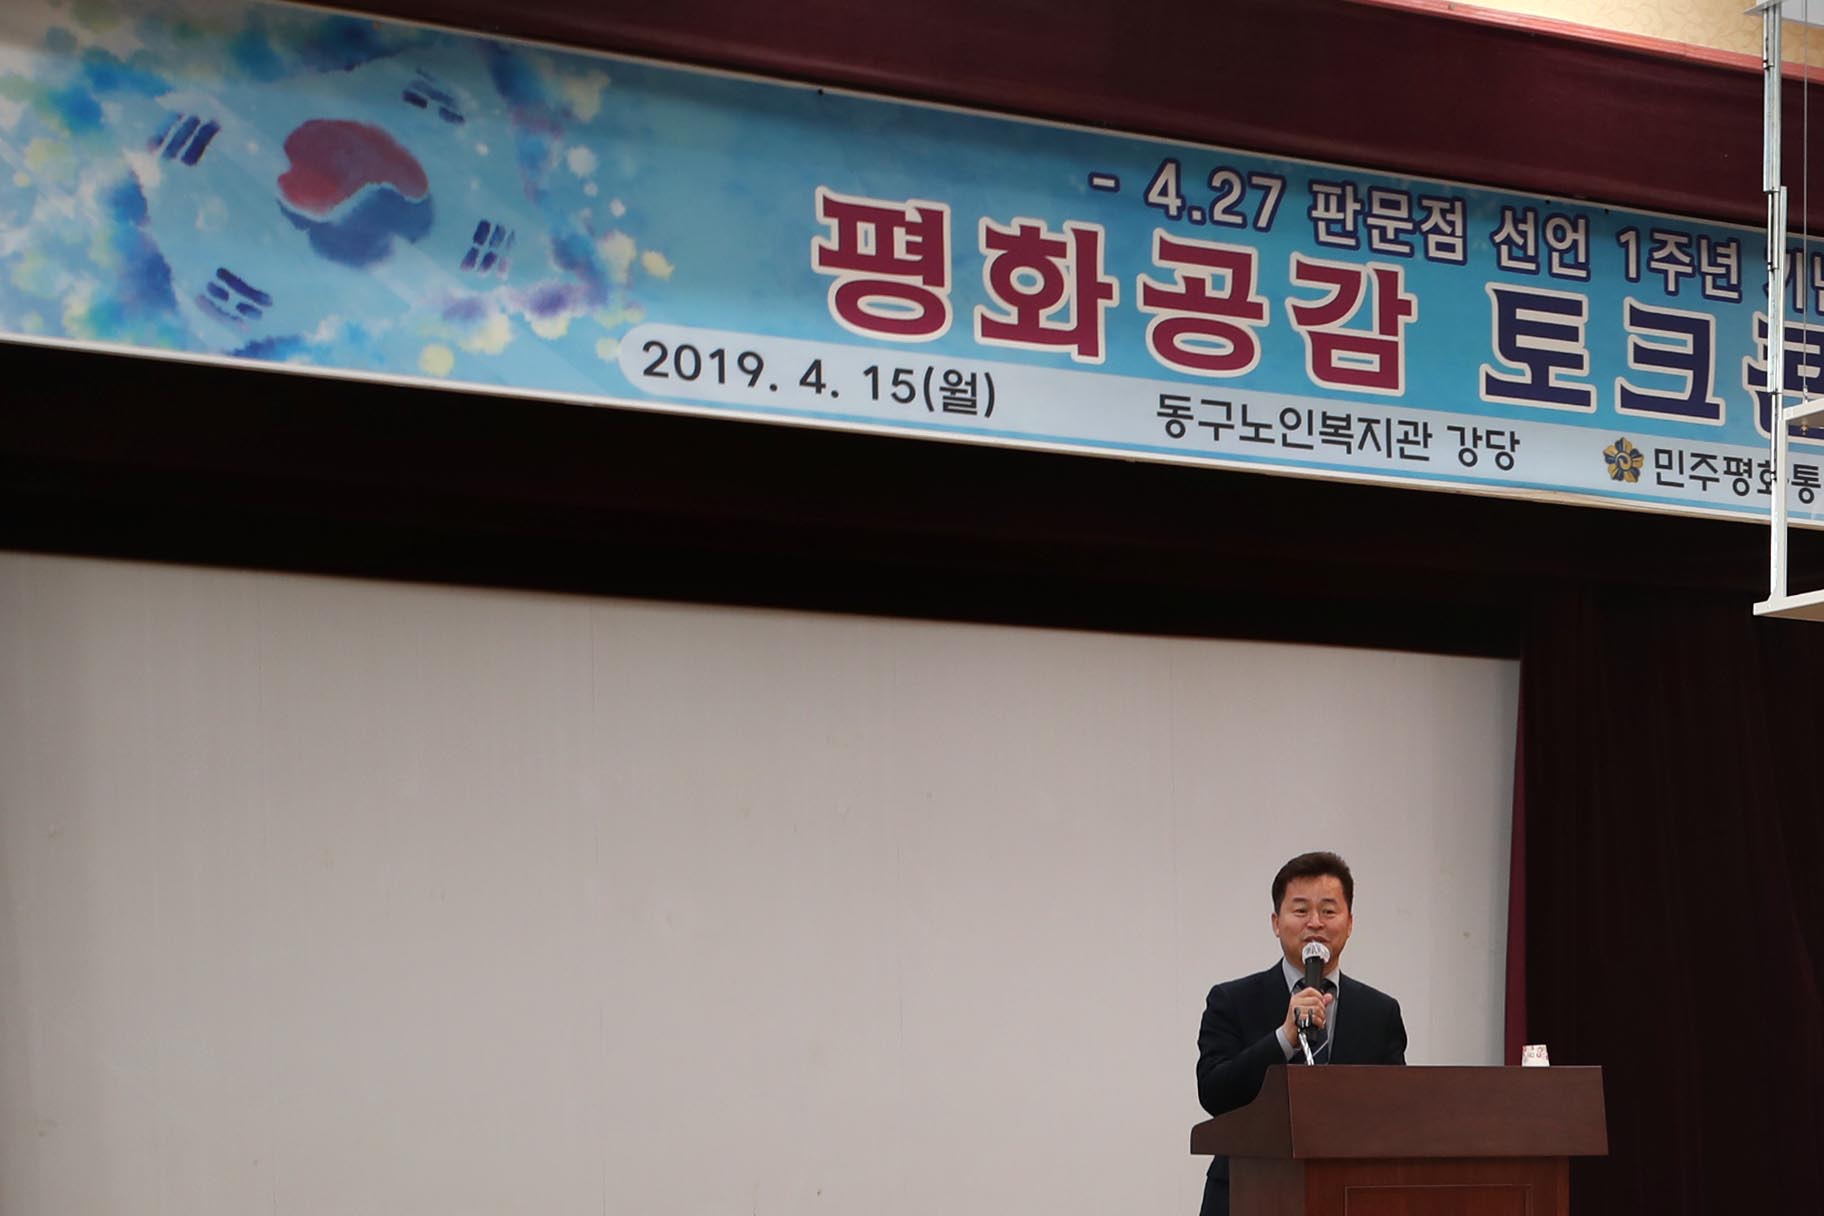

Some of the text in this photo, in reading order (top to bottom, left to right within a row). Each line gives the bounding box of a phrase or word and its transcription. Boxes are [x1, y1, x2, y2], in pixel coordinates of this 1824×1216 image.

[1146, 159, 1286, 231] 4.27
[1308, 181, 1466, 265] 판문점
[1491, 207, 1589, 280] 선언
[1618, 227, 1741, 301] 1주년
[812, 186, 1417, 395] 평화공감
[641, 339, 996, 418] 2019. 4. 15(월)
[1156, 393, 1521, 472] 동구노인복지관 강당
